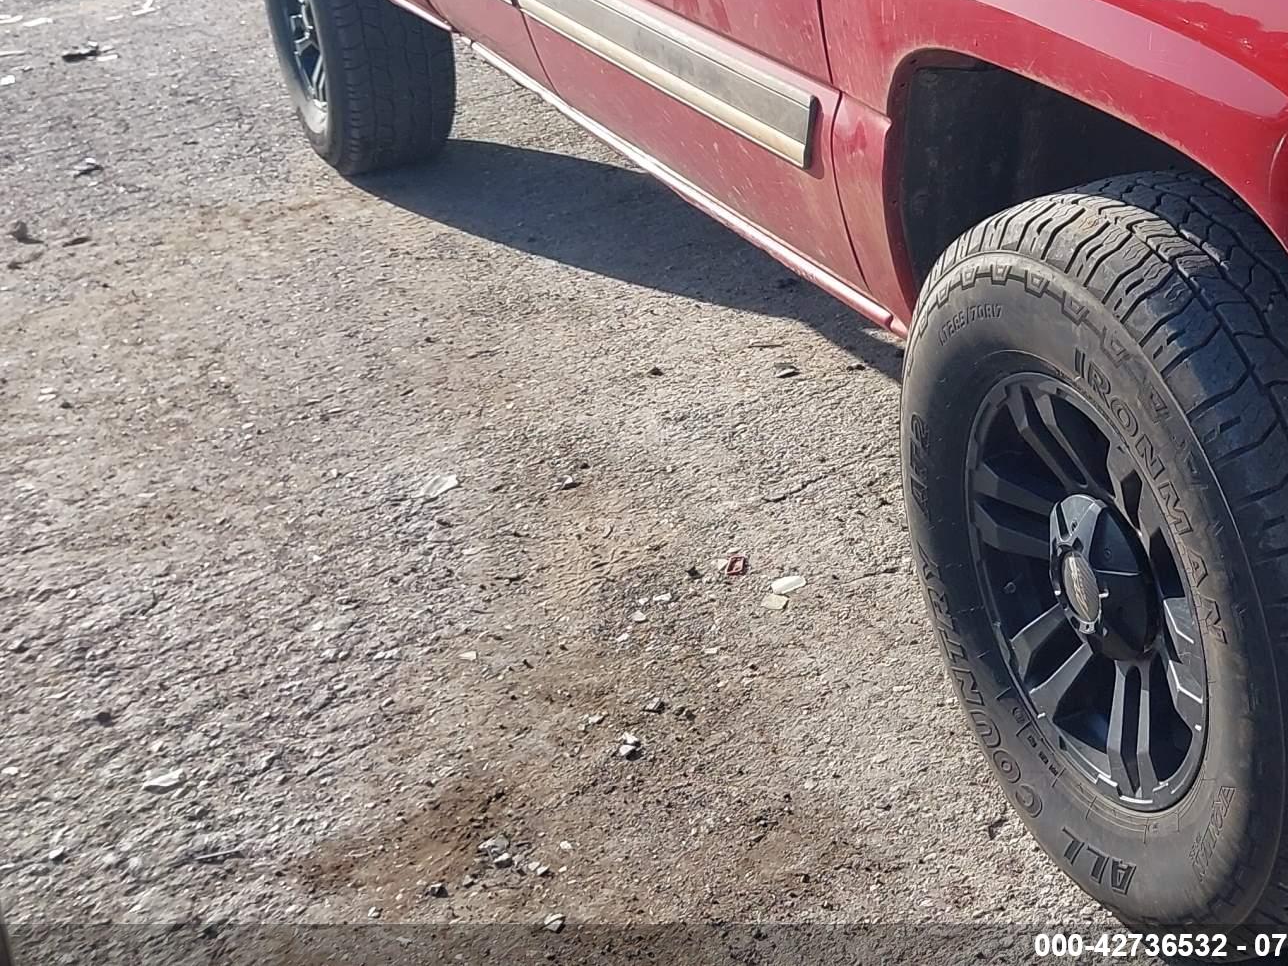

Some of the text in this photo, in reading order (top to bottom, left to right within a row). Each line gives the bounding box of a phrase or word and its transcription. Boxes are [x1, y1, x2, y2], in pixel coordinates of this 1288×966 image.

[1074, 347, 1229, 645] IRONMAN
[917, 540, 1043, 819] COUNTRY
[1062, 826, 1137, 895] ALL
